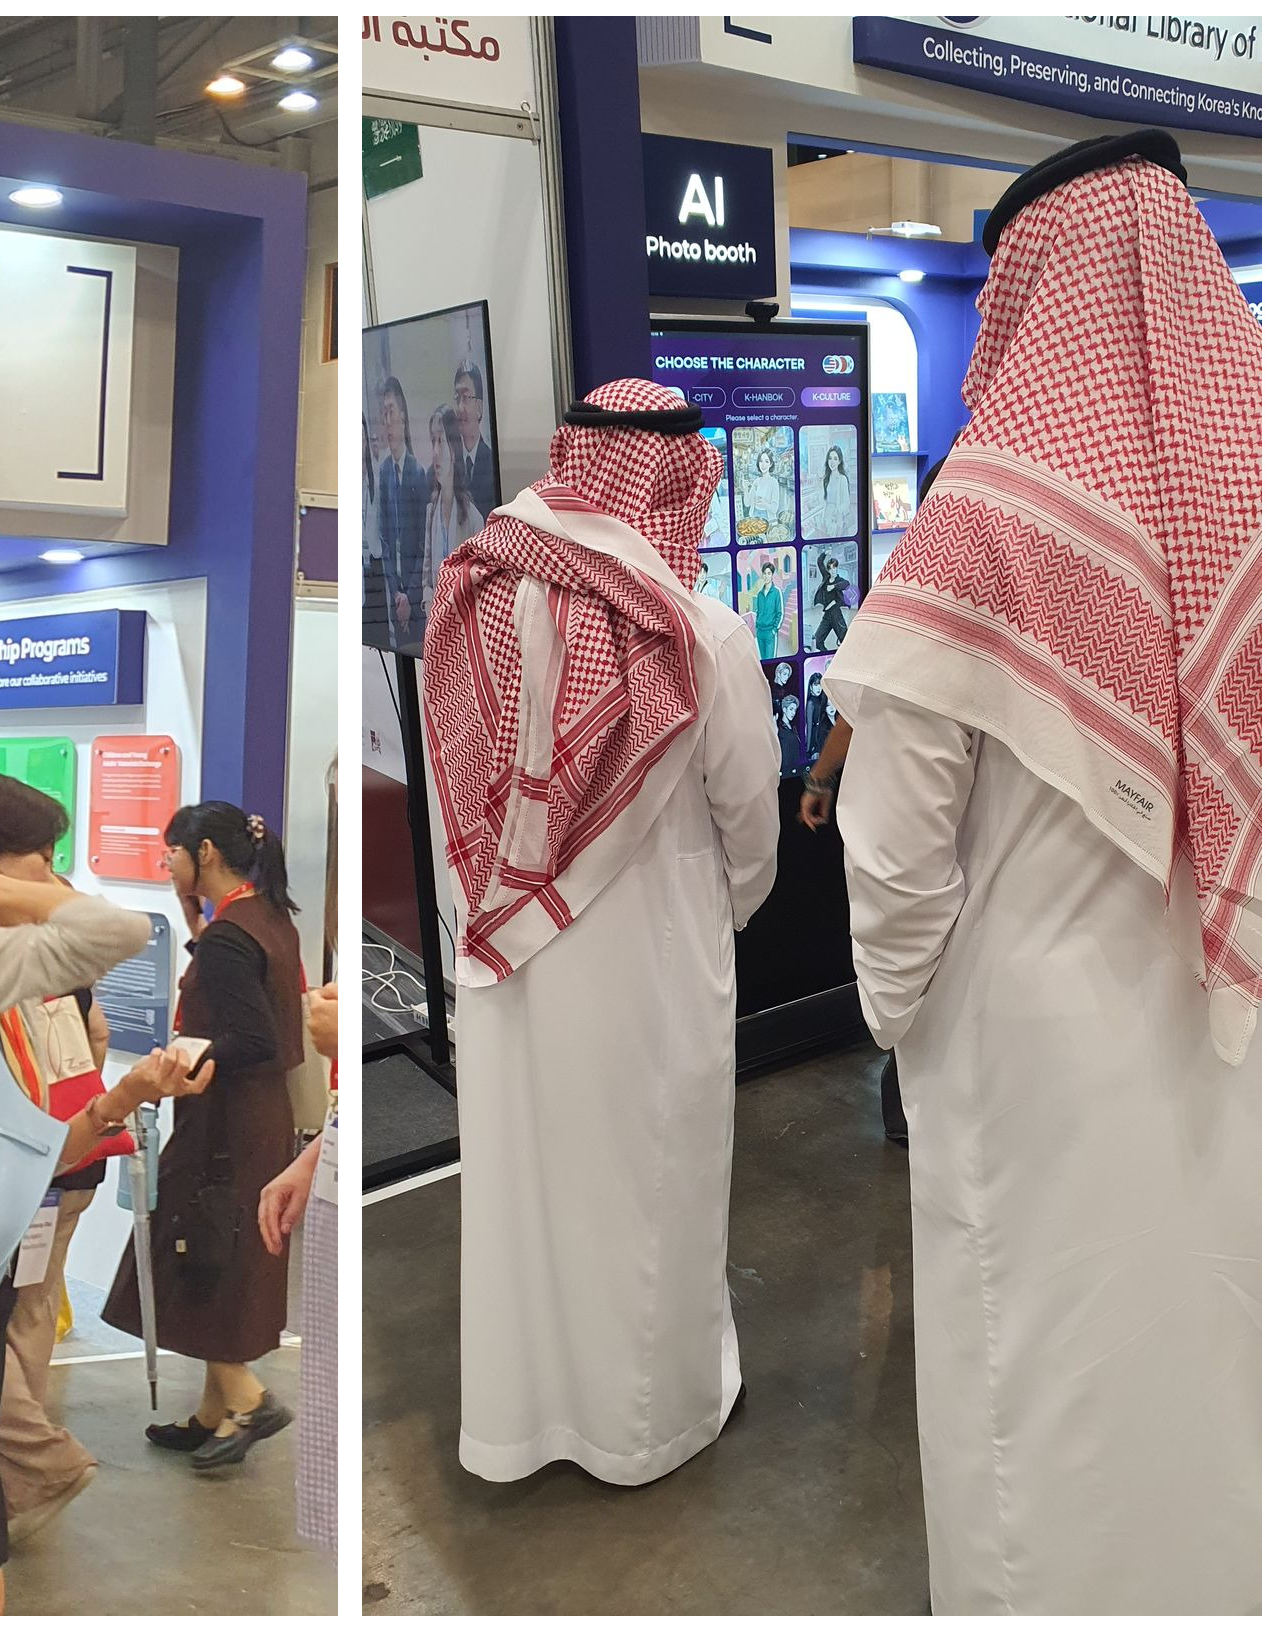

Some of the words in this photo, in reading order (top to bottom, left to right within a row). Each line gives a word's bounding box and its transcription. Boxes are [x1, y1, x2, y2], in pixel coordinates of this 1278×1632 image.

[1147, 16, 1228, 61] Library
[1233, 25, 1257, 59] of
[922, 36, 1007, 76] Collecting,
[1010, 54, 1091, 93] Preserving,
[1094, 75, 1120, 95] and
[1122, 78, 1195, 113] Connecting
[1197, 92, 1240, 117] Korea's
[678, 173, 725, 227] AI
[645, 235, 702, 261] Photo
[704, 238, 757, 264] booth
[654, 356, 709, 369] CHOOSE
[709, 356, 734, 370] THE
[735, 357, 806, 370] CHARACTER
[692, 393, 714, 402] -CITY
[744, 392, 784, 402] K-HANBOK
[812, 392, 851, 401] K-CULTURE
[725, 414, 746, 422] Please
[746, 413, 764, 421] select
[20, 636, 90, 663] Programs
[9, 677, 23, 687] our
[22, 671, 69, 687] collaborative
[69, 670, 109, 684] initiatives
[1114, 779, 1154, 813] MAYFAIR
